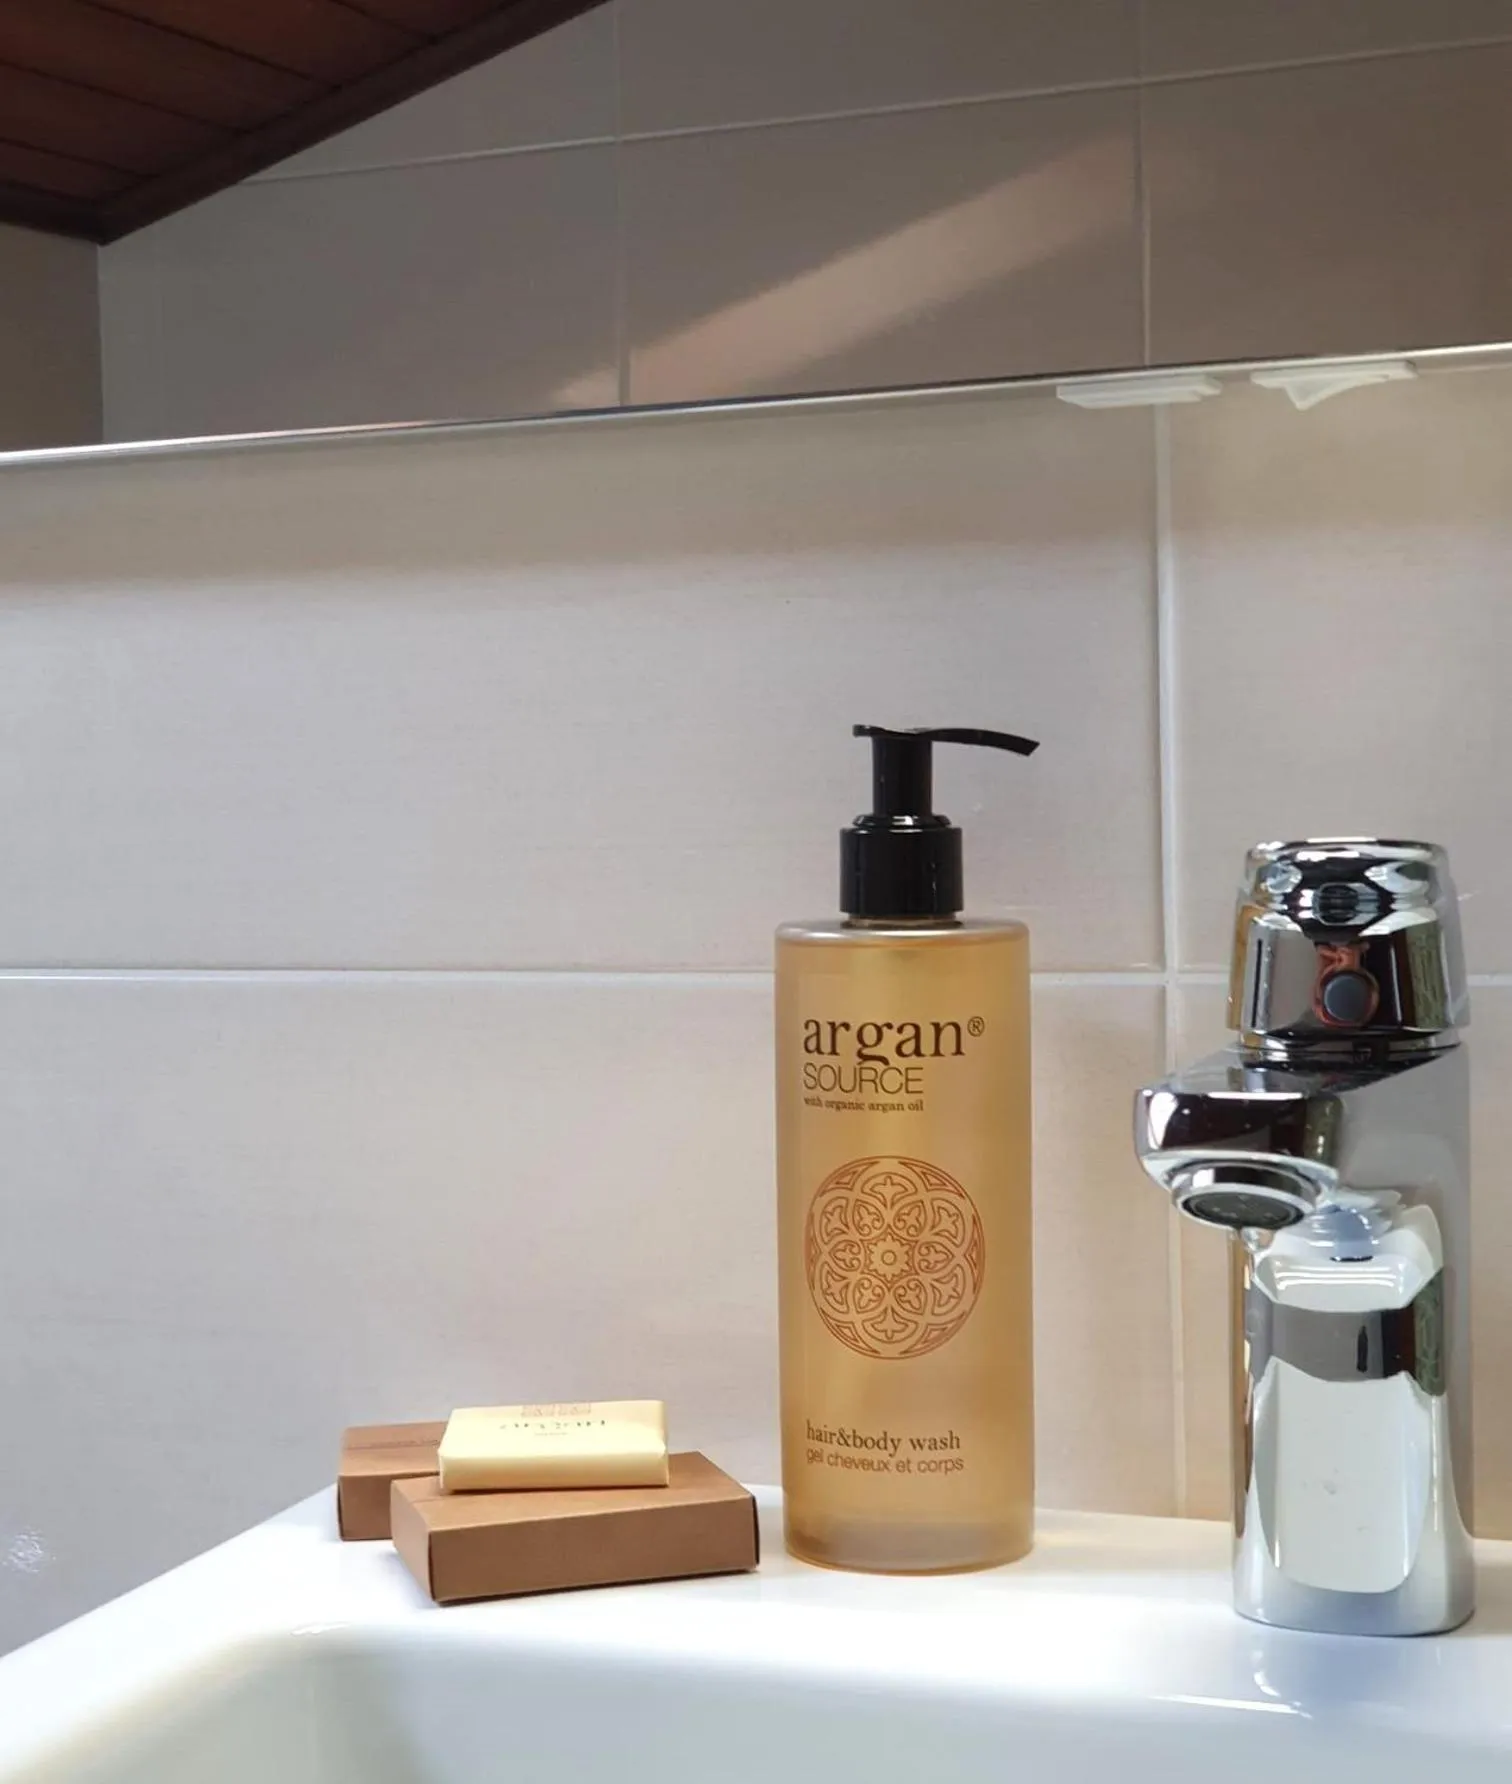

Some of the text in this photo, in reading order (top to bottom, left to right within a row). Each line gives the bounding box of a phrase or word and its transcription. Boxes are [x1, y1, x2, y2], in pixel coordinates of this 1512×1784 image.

[803, 1062, 924, 1095] SOURCE
[803, 1097, 924, 1113] with organic argan oil
[806, 1419, 961, 1457] hair&body wash
[806, 1448, 965, 1475] gel cheveux et corps
